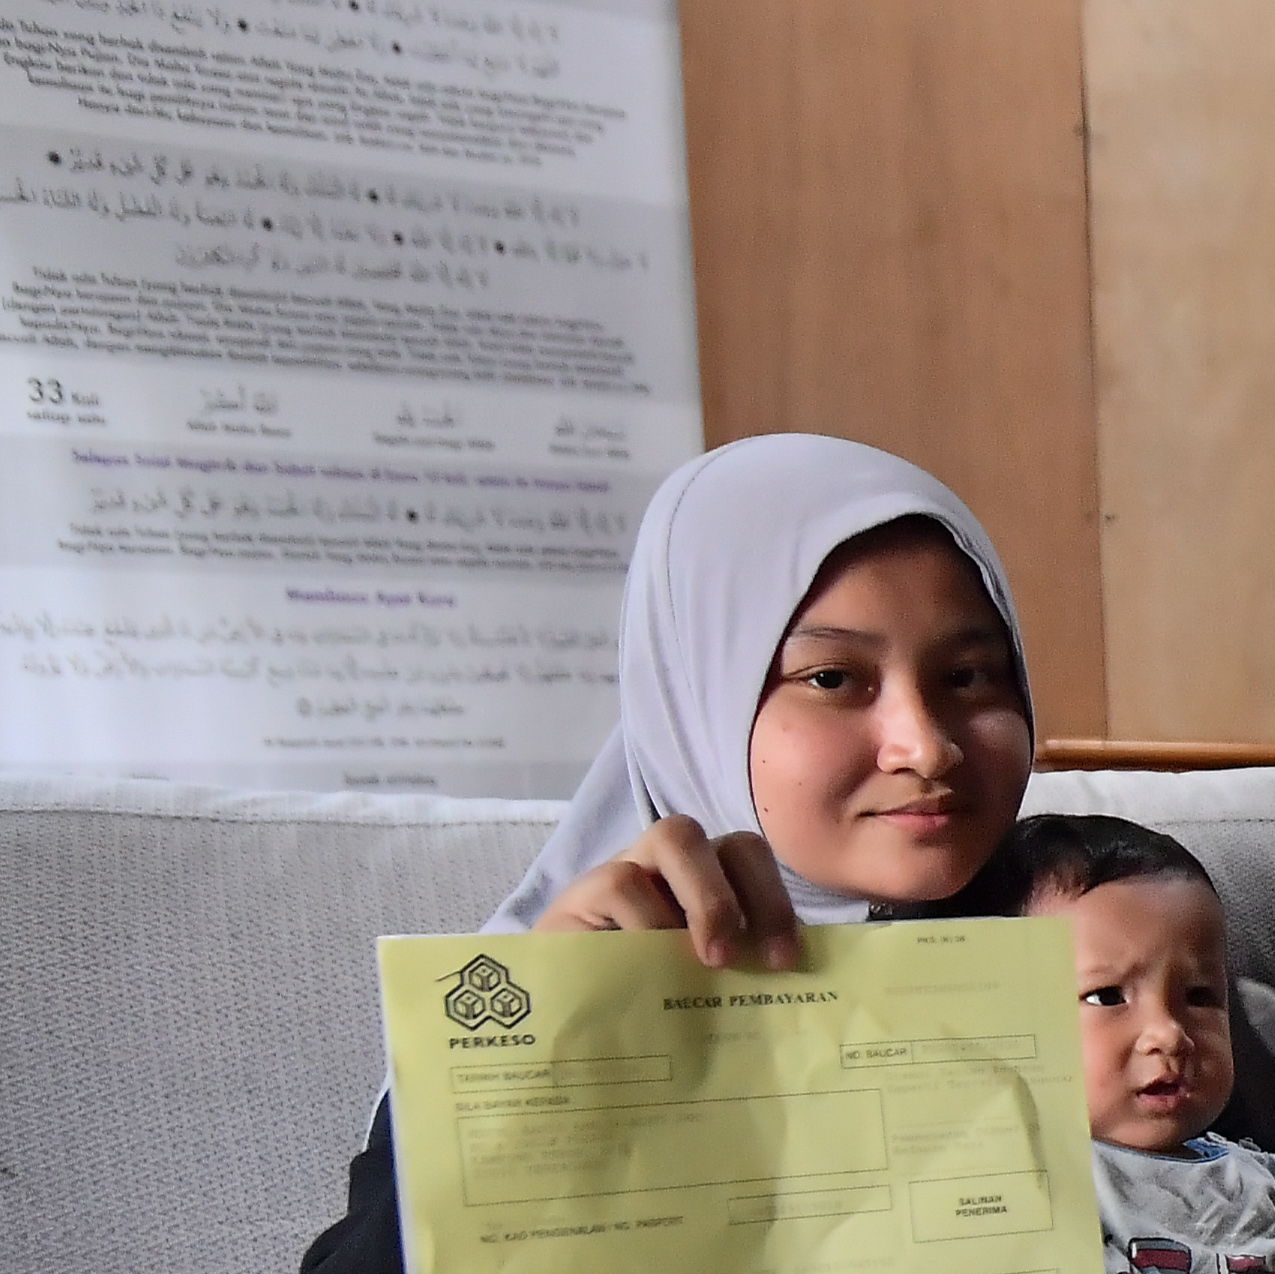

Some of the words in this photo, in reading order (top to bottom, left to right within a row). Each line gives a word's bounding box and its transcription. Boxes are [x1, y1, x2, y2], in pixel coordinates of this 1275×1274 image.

[27, 377, 63, 404] 33
[729, 990, 839, 1008] PEMBAYARAN
[449, 1034, 536, 1049] PERKESO
[955, 1205, 1008, 1217] PENERIMA
